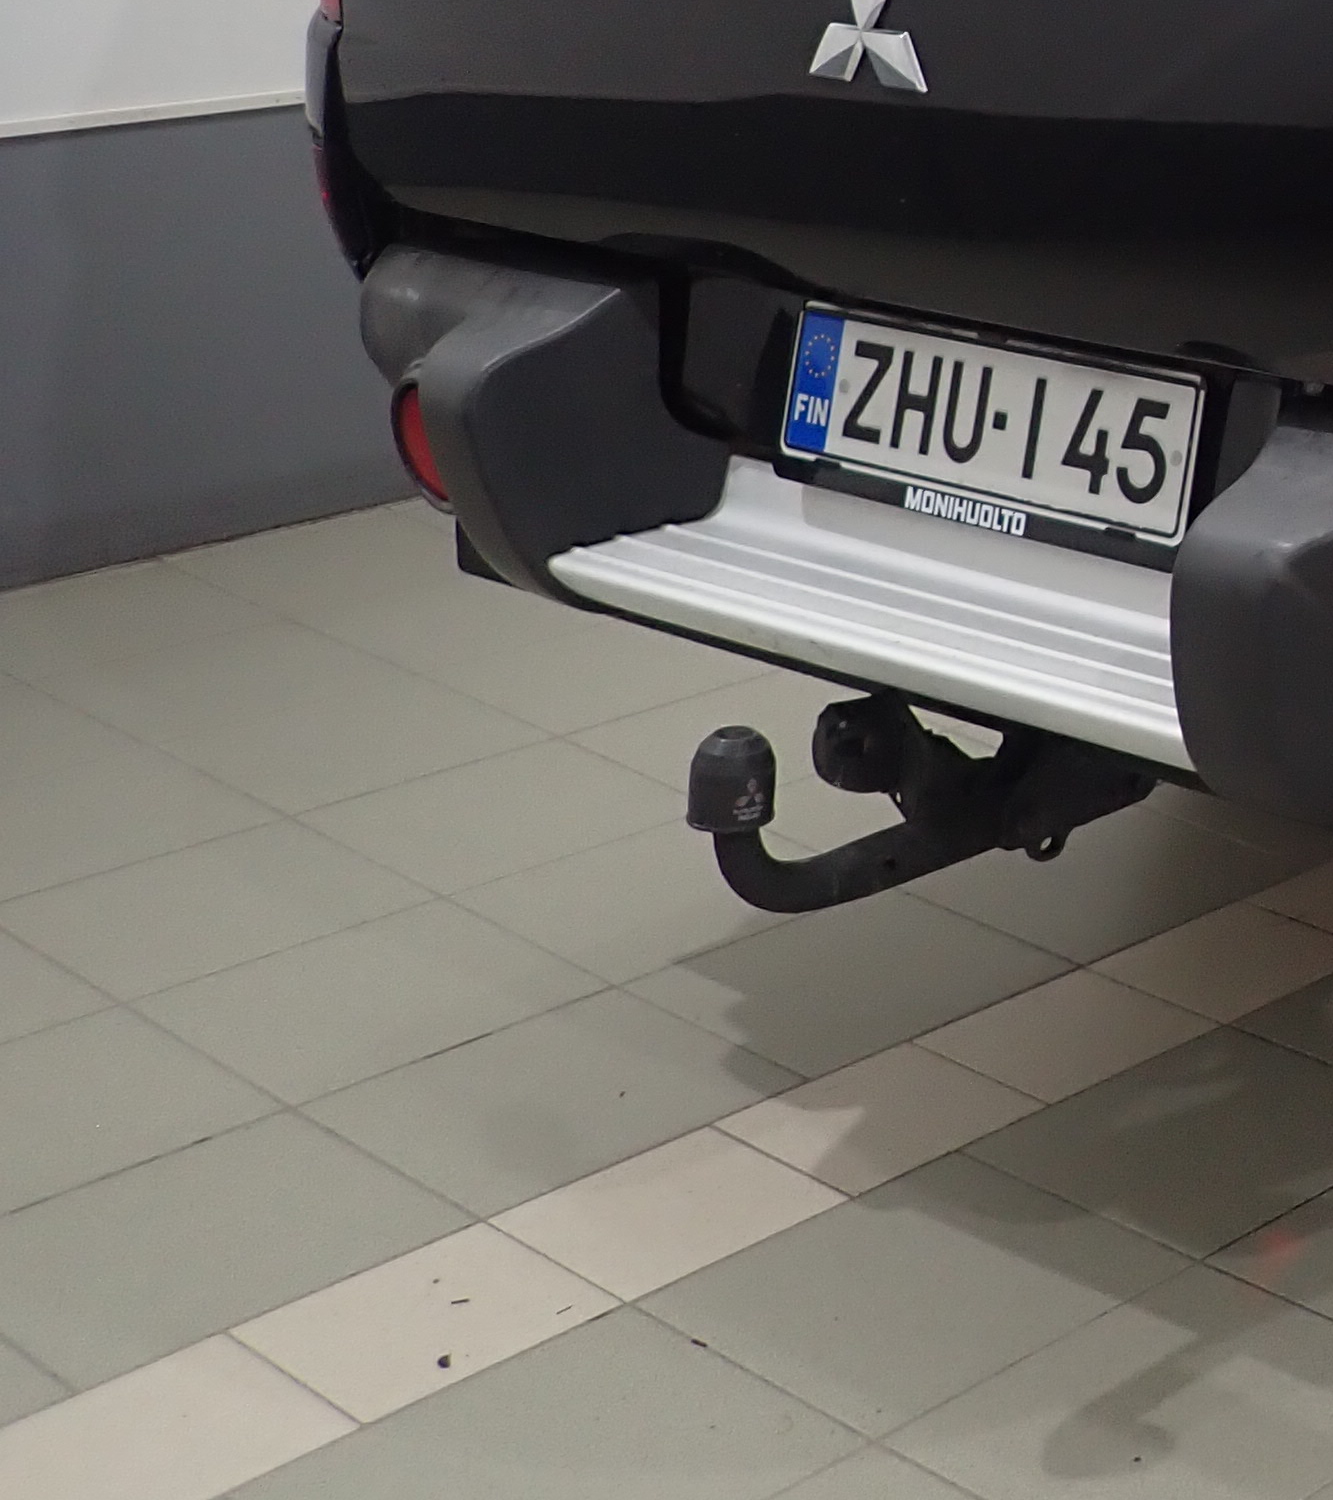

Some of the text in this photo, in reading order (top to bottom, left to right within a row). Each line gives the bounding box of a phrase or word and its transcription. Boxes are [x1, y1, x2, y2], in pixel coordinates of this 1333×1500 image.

[794, 392, 829, 427] FIN
[842, 341, 1171, 504] ZHU-145
[904, 485, 1026, 537] MONIHUOLTO
